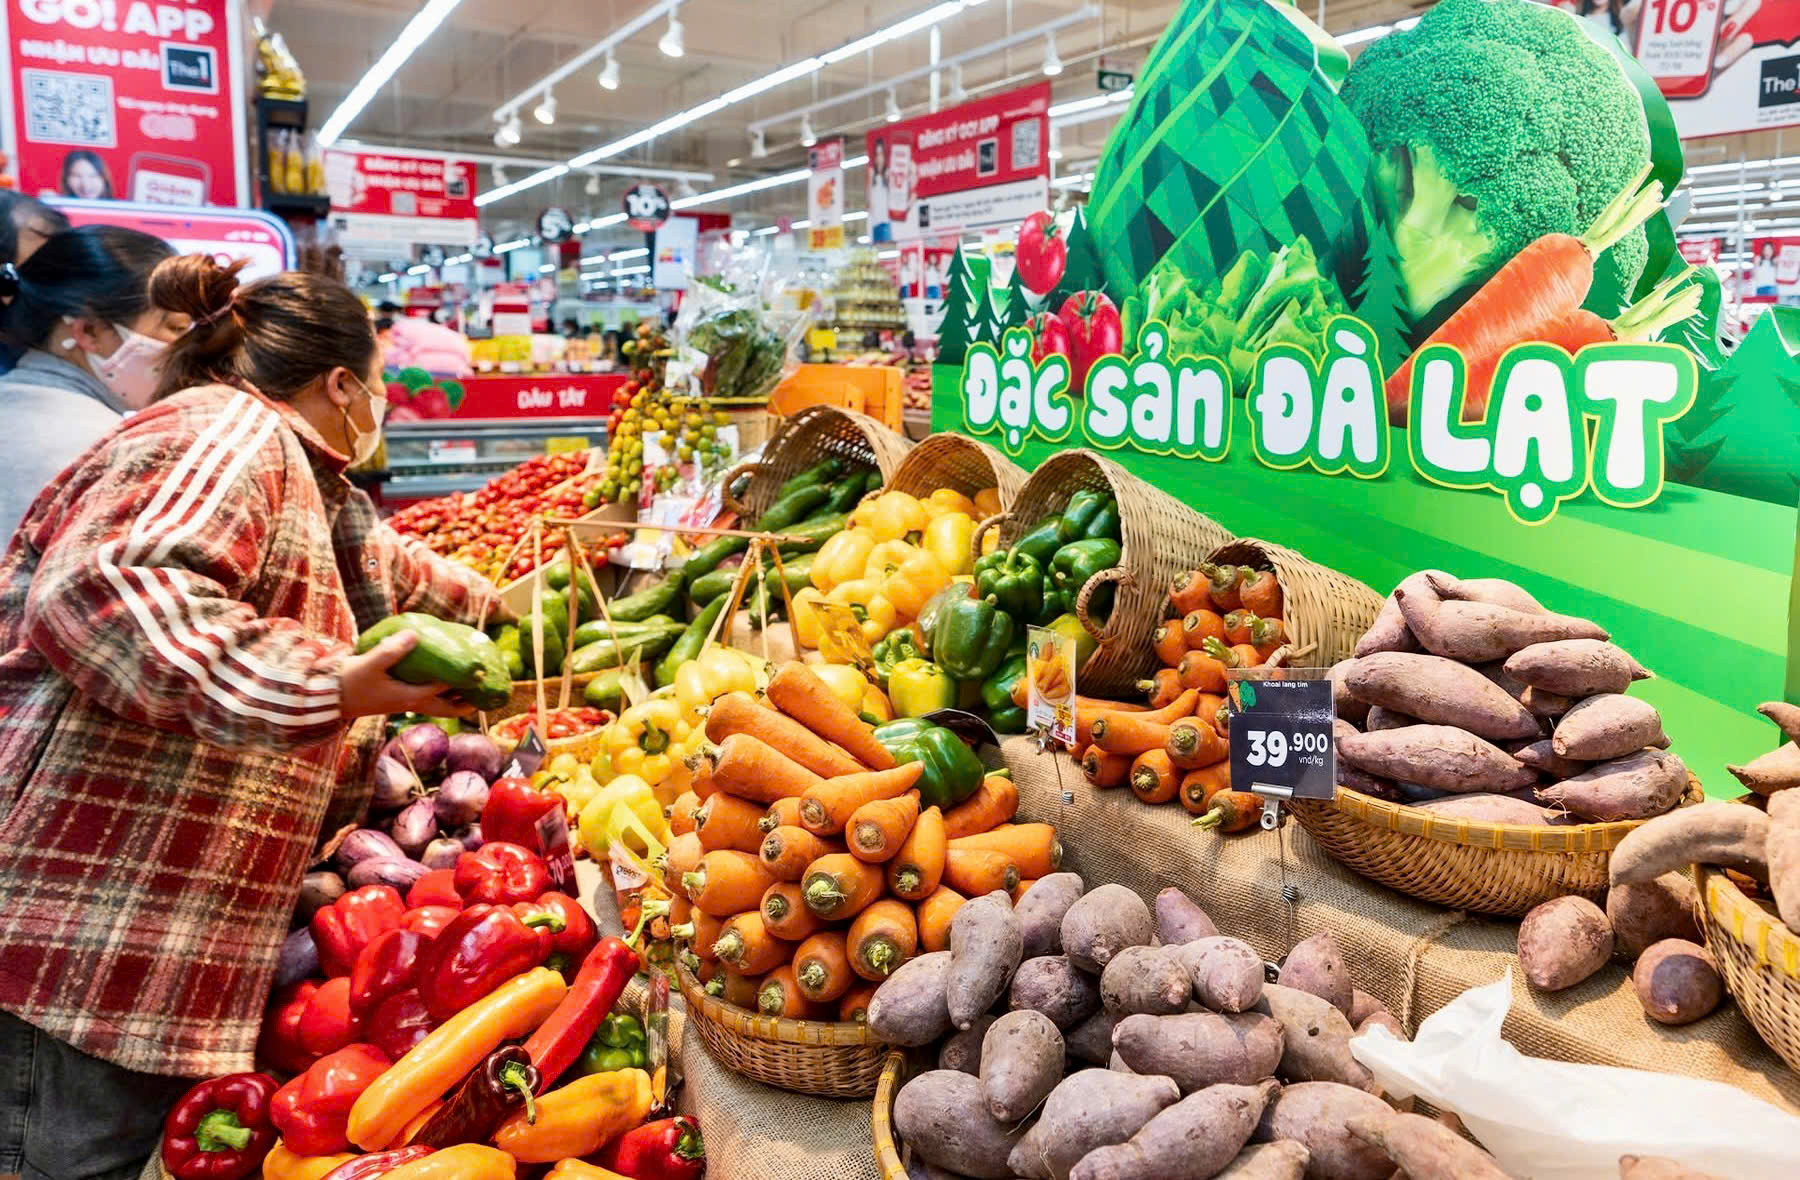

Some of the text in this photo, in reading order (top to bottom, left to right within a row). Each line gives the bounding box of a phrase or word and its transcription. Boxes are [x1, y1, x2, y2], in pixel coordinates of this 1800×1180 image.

[122, 1, 214, 41] APP
[964, 339, 1069, 447] Đặc
[1256, 329, 1377, 463] ĐÀ
[1420, 359, 1678, 508] LẠT
[1281, 681, 1296, 689] lang
[1298, 756, 1324, 767] vnd/kg
